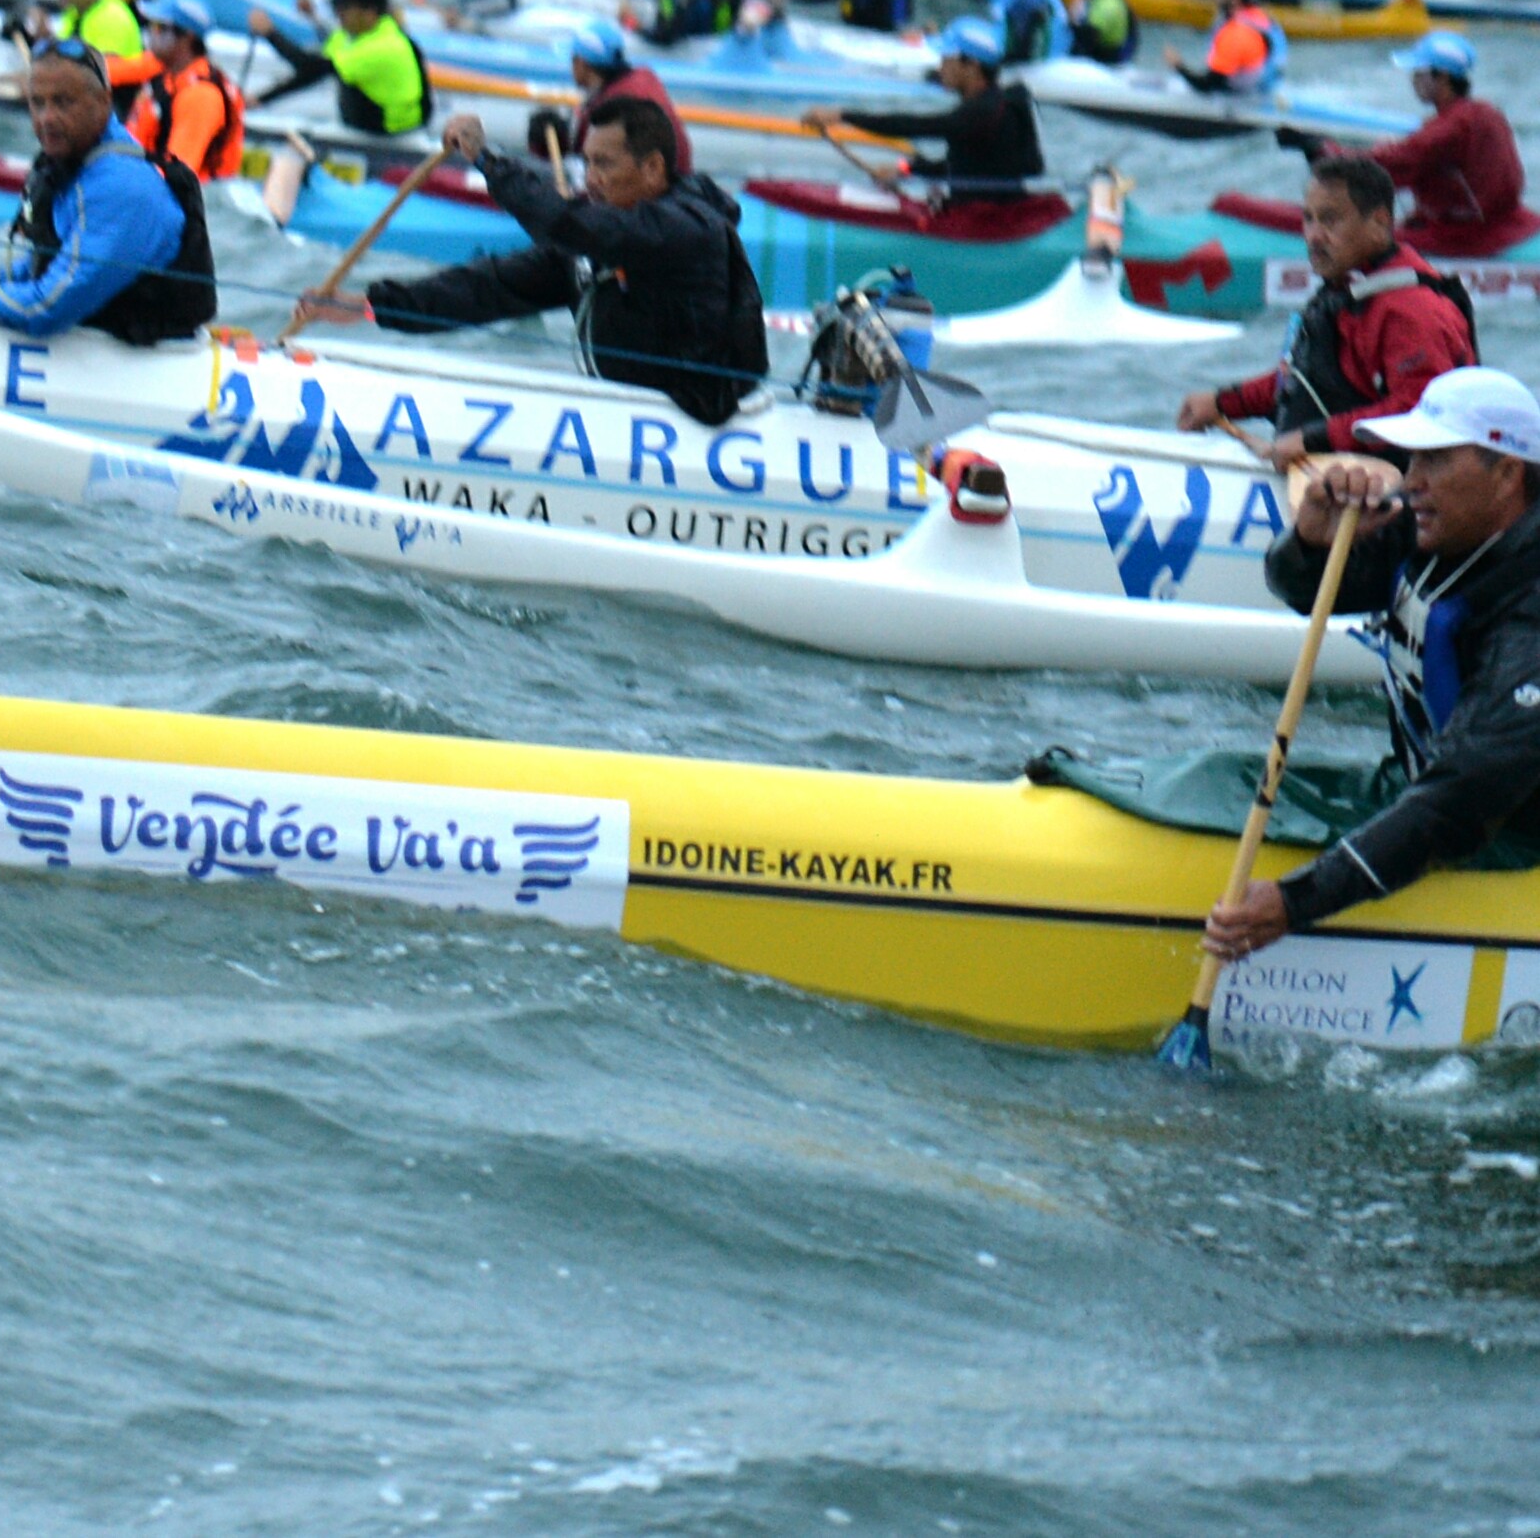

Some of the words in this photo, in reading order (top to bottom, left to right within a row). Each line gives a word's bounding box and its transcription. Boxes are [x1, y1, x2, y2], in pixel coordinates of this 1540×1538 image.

[403, 477, 551, 526] WAKA
[100, 792, 339, 878] Vendée
[366, 816, 501, 874] Va'a
[643, 837, 954, 891] IDOINE-KAYAK.FR
[1223, 993, 1371, 1032] PROVENCE
